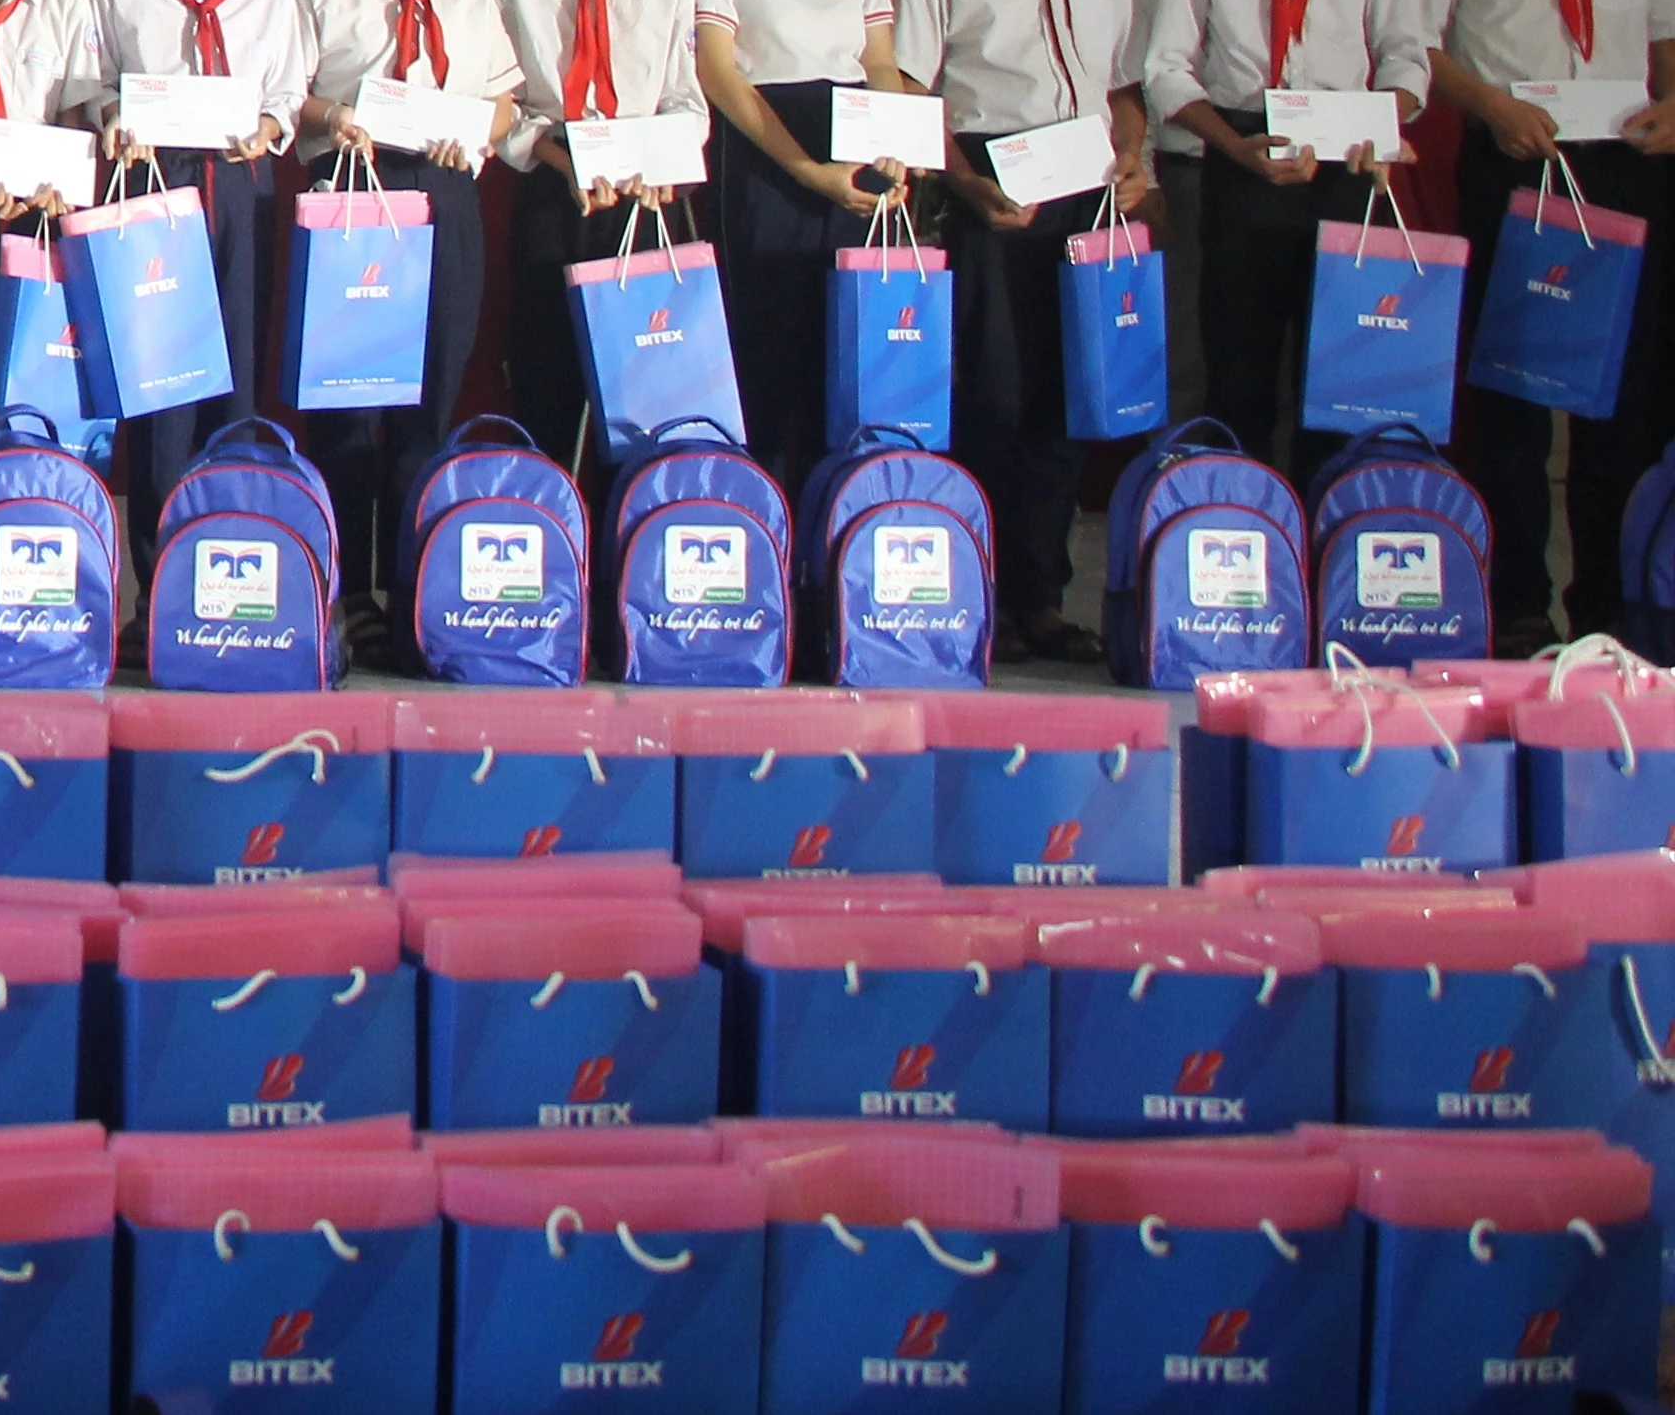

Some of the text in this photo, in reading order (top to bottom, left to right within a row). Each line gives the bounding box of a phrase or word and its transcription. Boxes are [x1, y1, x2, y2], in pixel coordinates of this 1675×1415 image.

[134, 279, 178, 299] BITEX
[346, 286, 390, 299] BITEX
[1528, 280, 1571, 301] BITEX
[1116, 313, 1139, 327] BITEX
[1358, 315, 1408, 330] BITEX
[636, 329, 684, 348] BITEX
[888, 329, 921, 341] BITEX
[1014, 864, 1097, 885] BITEX
[861, 1091, 954, 1114] BITEX
[1144, 1096, 1243, 1121] BITEX
[1438, 1093, 1530, 1117] BITEX
[228, 1102, 325, 1127] BITEX
[539, 1103, 632, 1126] BITEX
[230, 1360, 332, 1384] BITEX
[561, 1362, 662, 1388] BITEX
[863, 1359, 967, 1385] BITEX
[1165, 1357, 1267, 1382] BITEX
[1484, 1358, 1574, 1384] BITEX
